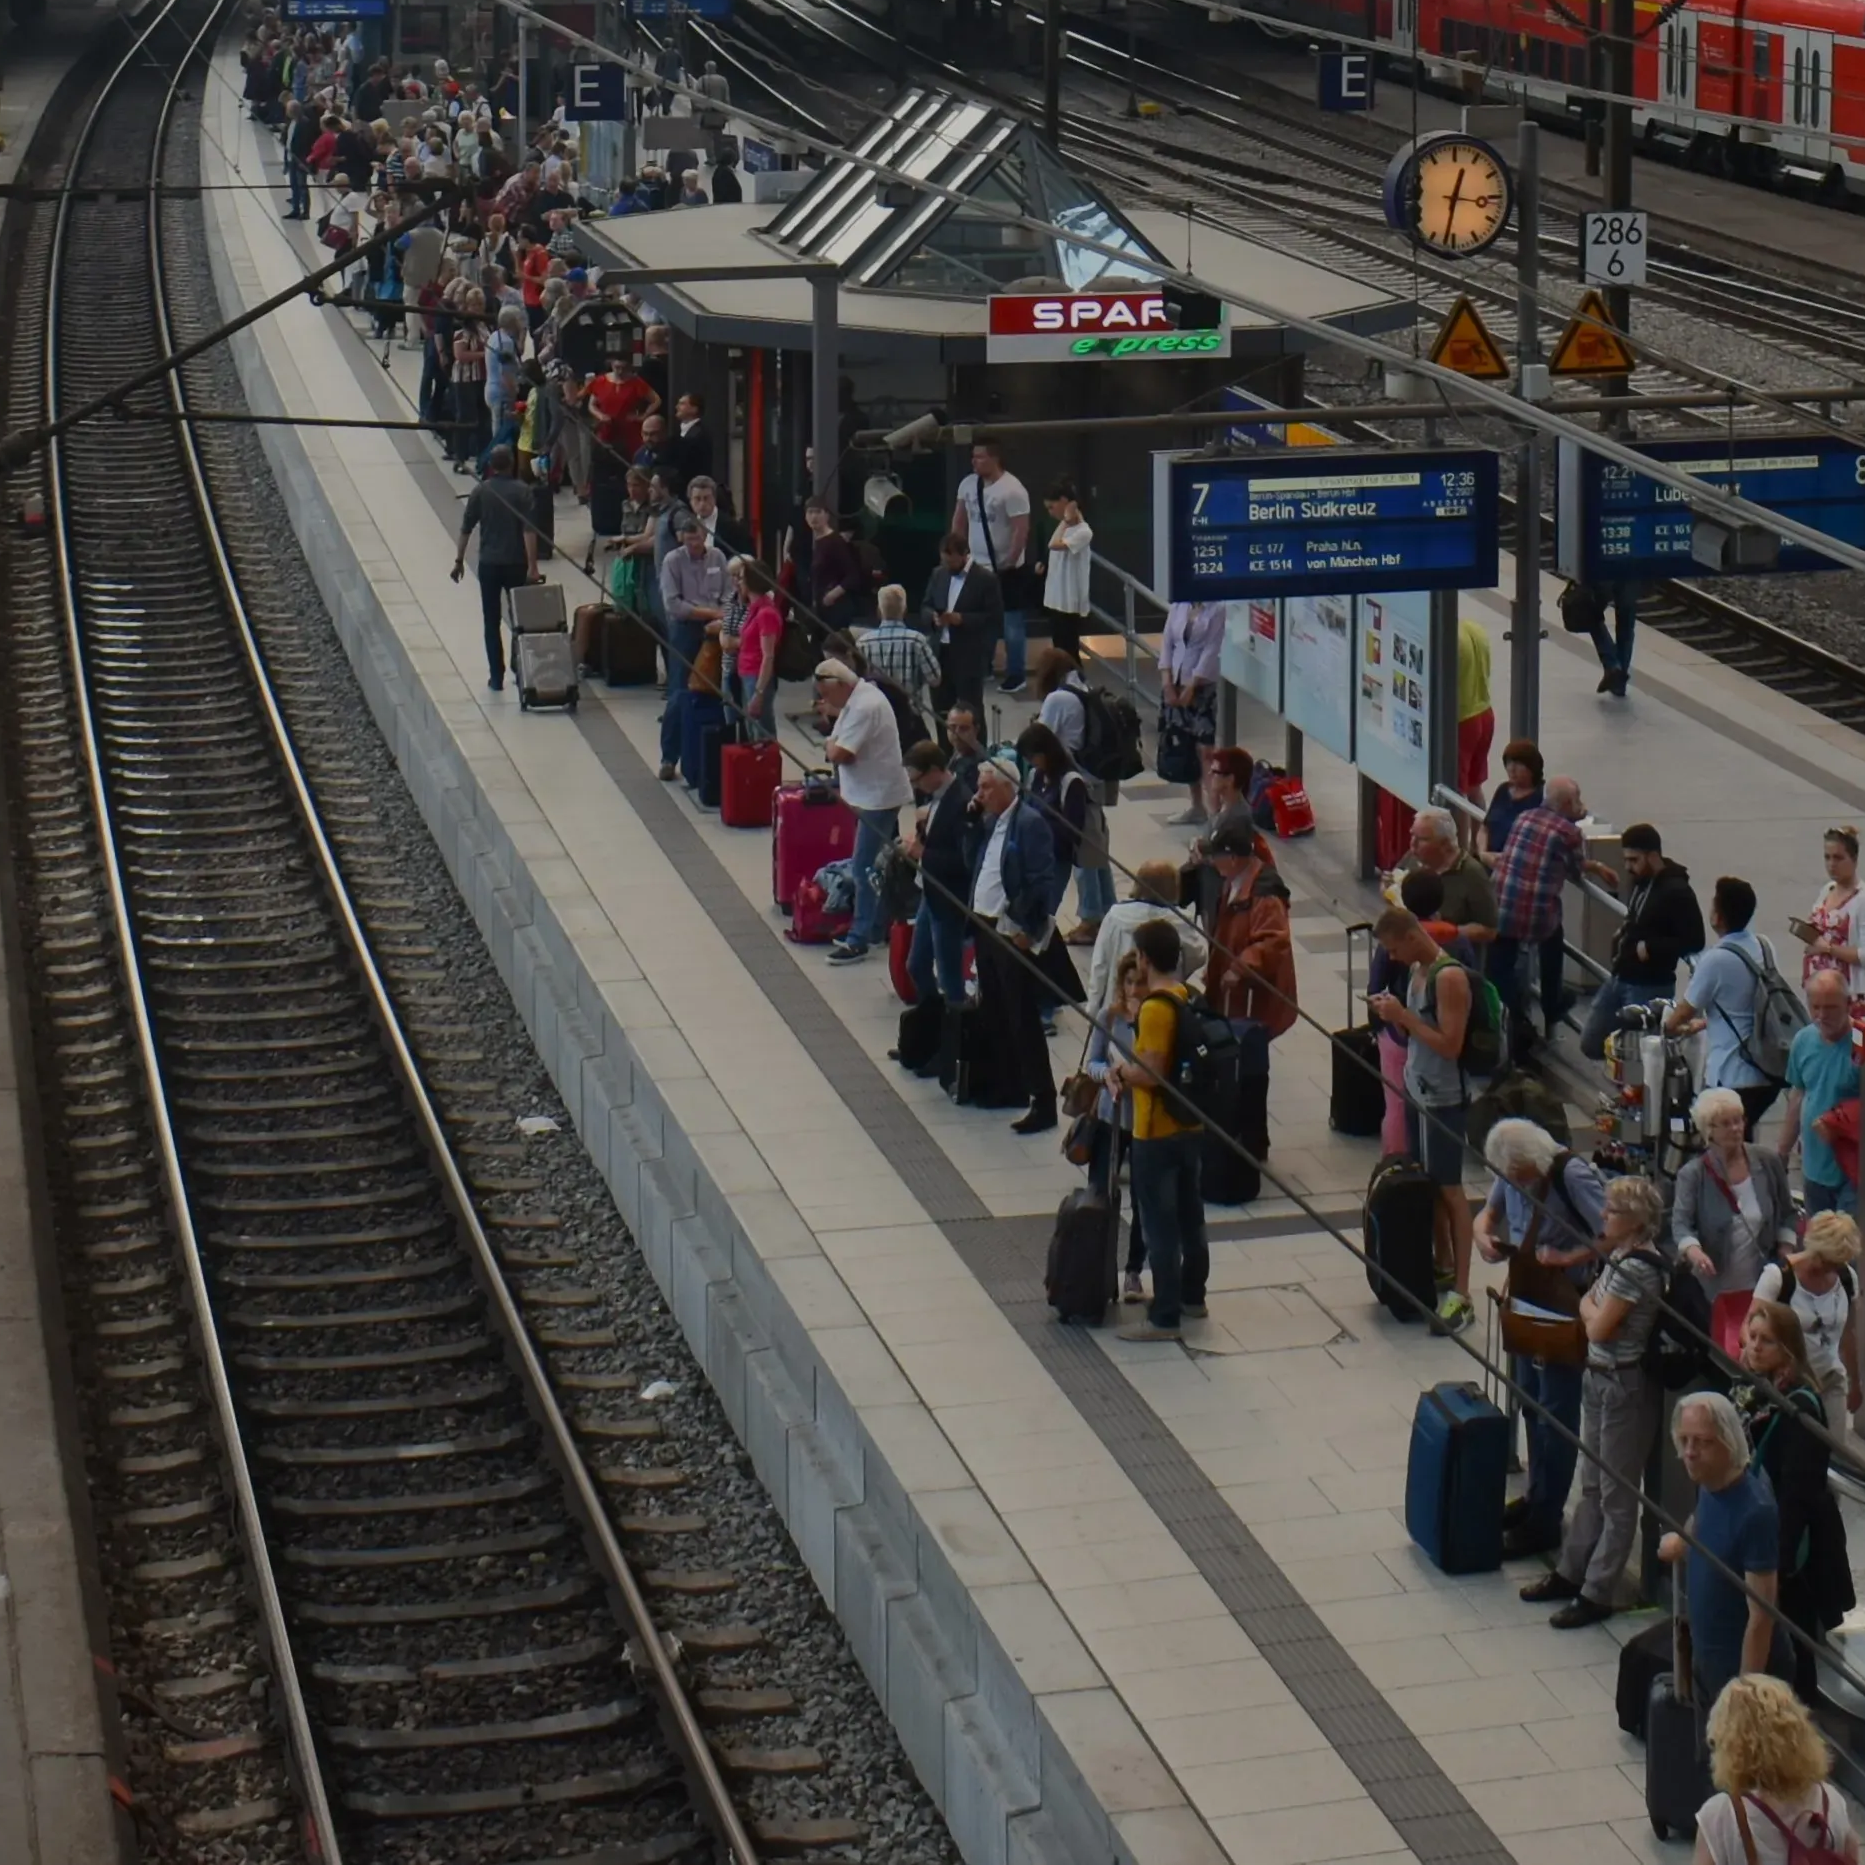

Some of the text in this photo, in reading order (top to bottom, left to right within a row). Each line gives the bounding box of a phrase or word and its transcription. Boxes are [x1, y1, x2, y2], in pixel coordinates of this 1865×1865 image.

[573, 65, 601, 108] E
[1341, 56, 1368, 98] E
[1592, 217, 1643, 247] 286
[1608, 249, 1625, 278] 6
[1032, 299, 1167, 330] SPAR
[1071, 333, 1223, 357] epress
[1439, 471, 1475, 487] 12:36
[1191, 482, 1210, 515] 7
[1248, 500, 1377, 521] Berlin Südkreuz
[1306, 540, 1338, 553] Praha
[1249, 561, 1267, 573] ICE
[1270, 559, 1293, 572] 1514
[1329, 555, 1377, 567] München
[1381, 553, 1402, 566] Hbf
